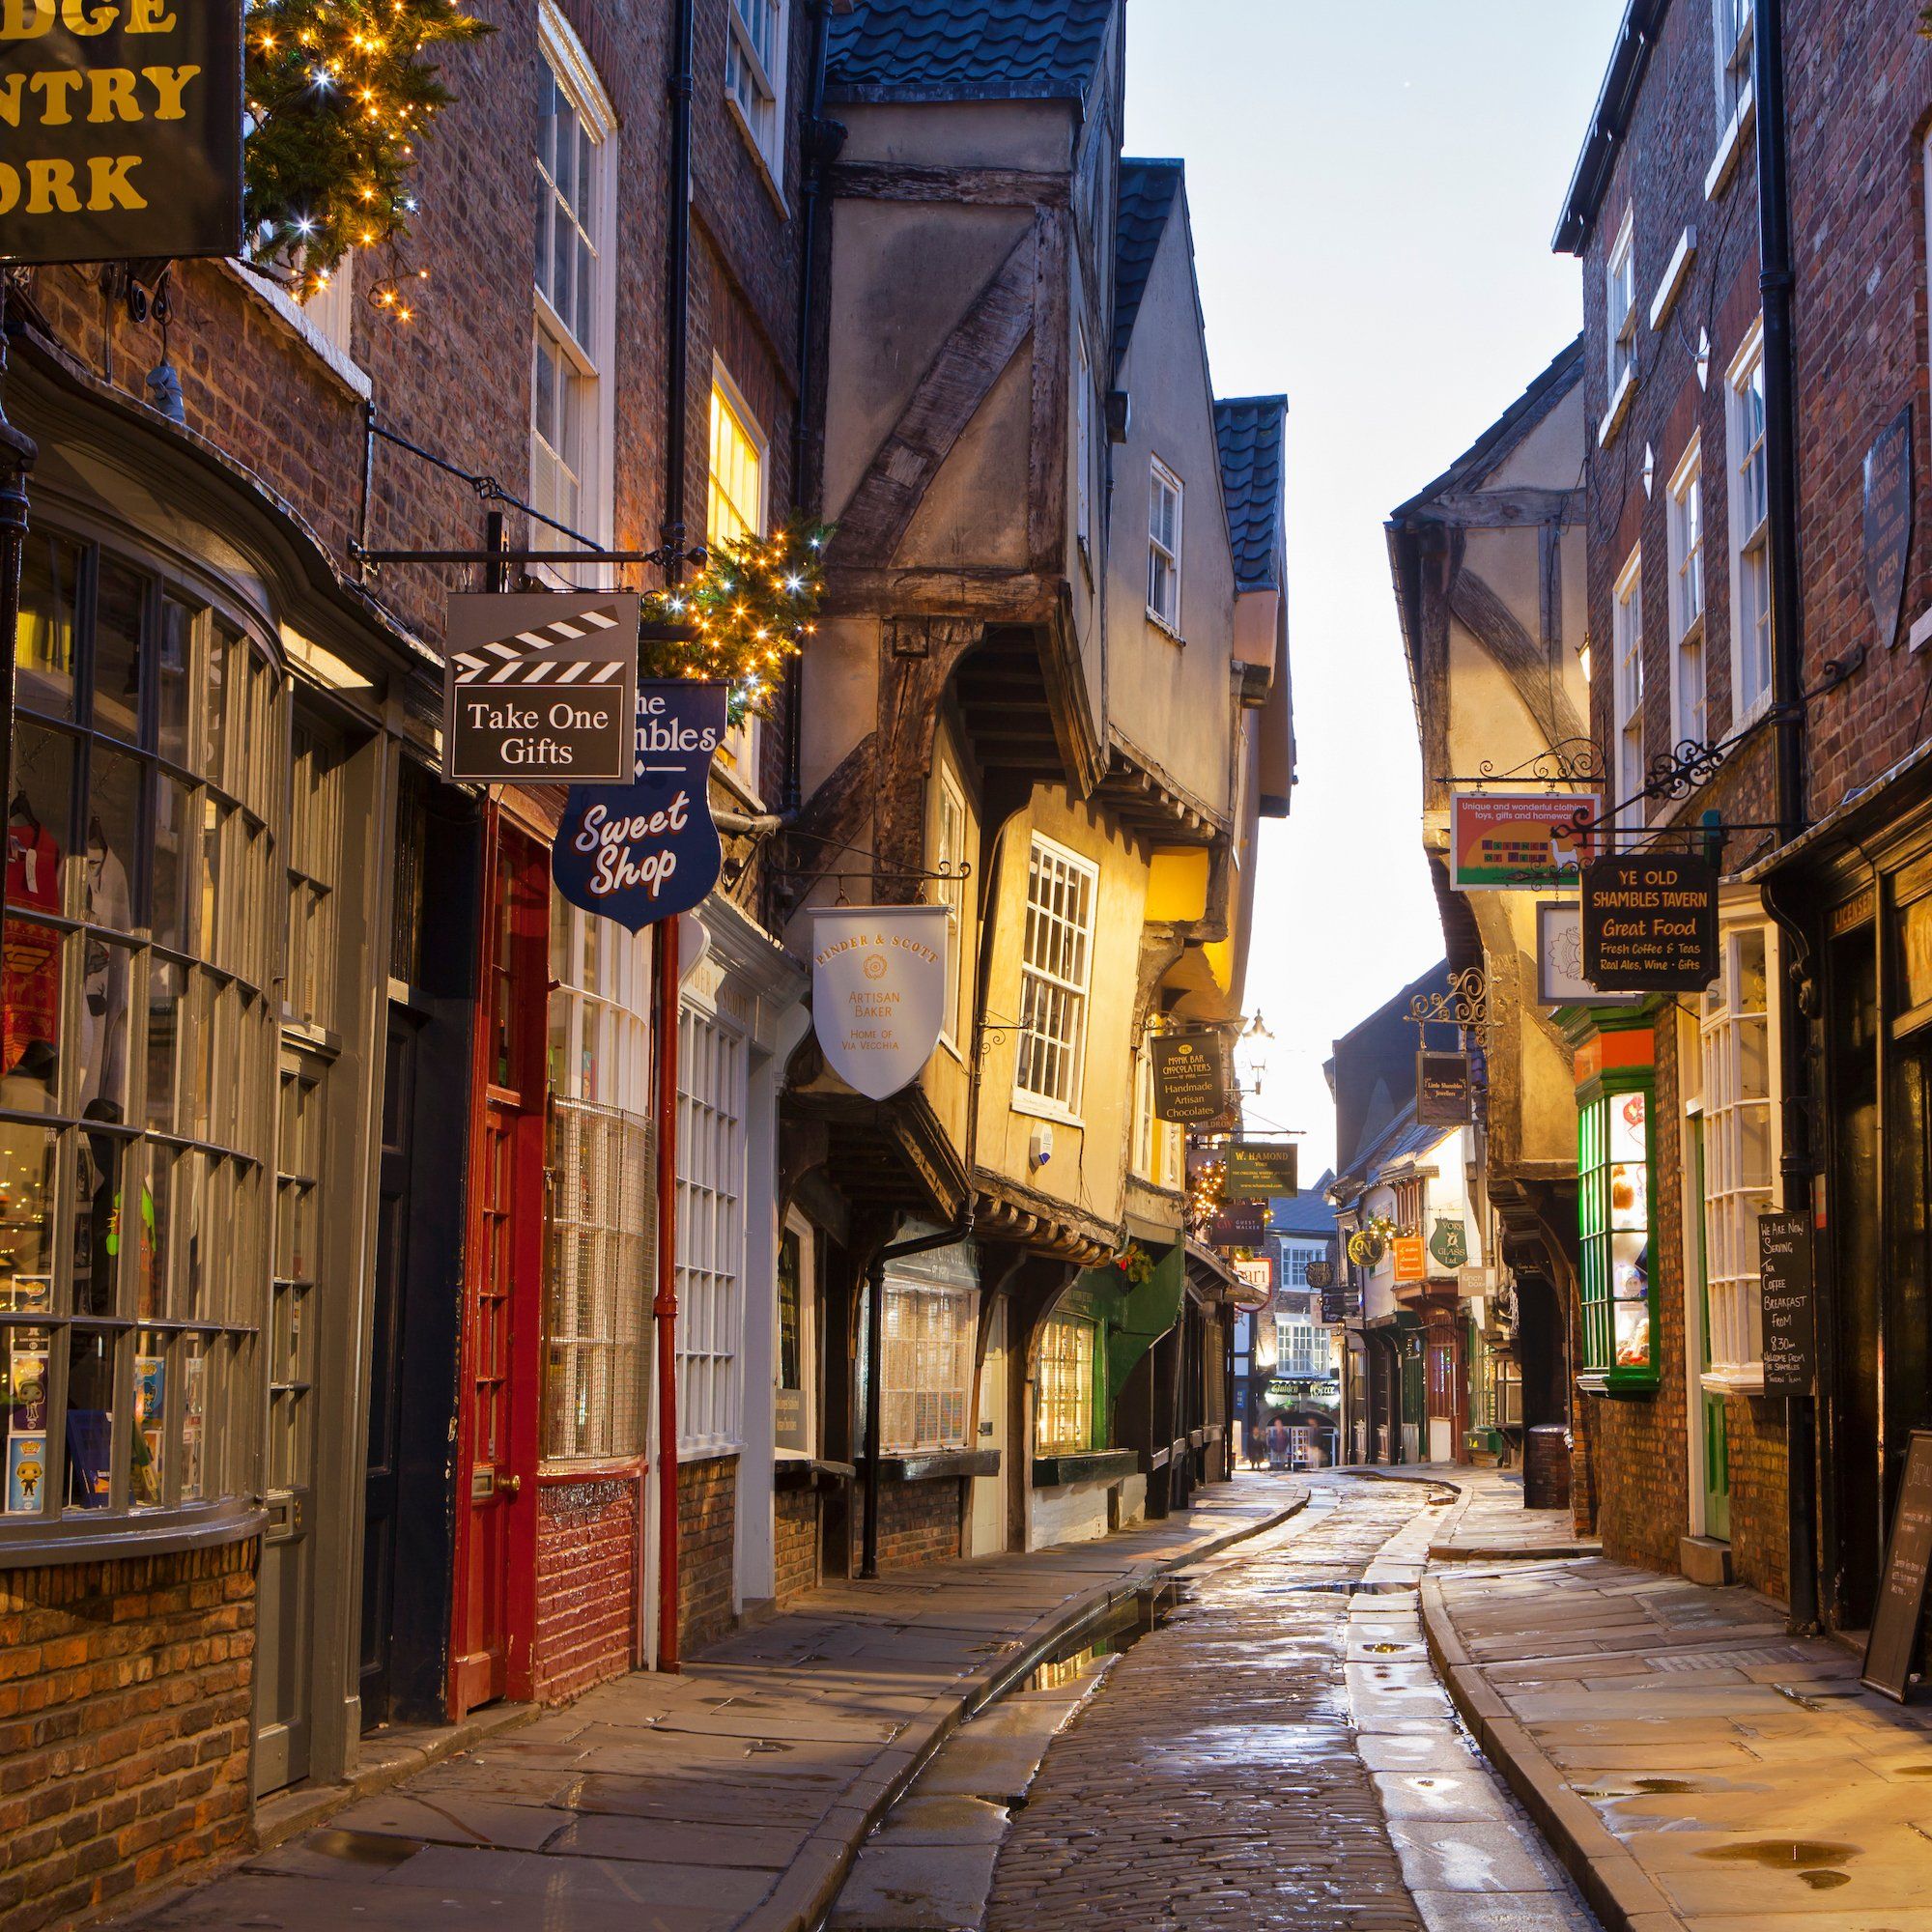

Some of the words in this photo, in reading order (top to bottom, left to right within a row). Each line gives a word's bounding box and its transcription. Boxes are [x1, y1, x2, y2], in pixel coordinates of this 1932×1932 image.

[1877, 549, 1899, 587] OPEN
[636, 689, 666, 715] he
[468, 703, 539, 730] Take
[549, 703, 609, 730] One
[635, 717, 716, 752] mbles
[500, 737, 573, 765] Gifts
[1462, 802, 1491, 811] Unique
[1512, 803, 1551, 811] wonderful
[576, 790, 690, 852] Sweet
[589, 844, 677, 897] Shop
[1619, 870, 1637, 885] YE
[1645, 870, 1678, 885] OLD
[1593, 892, 1660, 907] SHAMBLES
[1662, 892, 1707, 907] TAVERN
[1603, 918, 1646, 936] Great
[1652, 918, 1696, 936] Food
[815, 935, 867, 968] PINDER
[874, 934, 885, 946] &
[891, 935, 939, 965] SCOTT
[1601, 943, 1630, 954] Fresh
[1633, 943, 1662, 954] Coffee
[1666, 943, 1674, 954] &
[1678, 943, 1700, 953] Teas
[1600, 959, 1619, 970] Real
[1620, 959, 1642, 971] Ales,
[1644, 959, 1668, 970] Wine
[1678, 959, 1700, 970] Gifts
[849, 991, 900, 1004] ARTISAN
[855, 1005, 892, 1018] BAKER
[850, 1030, 877, 1039] HOME
[881, 1030, 893, 1039] OF
[841, 1040, 856, 1050] VIA
[861, 1040, 899, 1051] VECCHIA
[1168, 1056, 1187, 1065] MONK
[1190, 1055, 1205, 1064] BAR
[1162, 1064, 1211, 1075] CHOCOLATIERS
[1165, 1082, 1213, 1094] Handmade
[1175, 1094, 1205, 1104] Artisan
[1166, 1106, 1214, 1118] Chocolates
[1236, 1151, 1246, 1160] W.
[1442, 1221, 1464, 1230] YORK
[1437, 1247, 1465, 1256] GLASS
[1764, 1295, 1807, 1311] BREAKFAST
[1772, 1313, 1792, 1327] FROM
